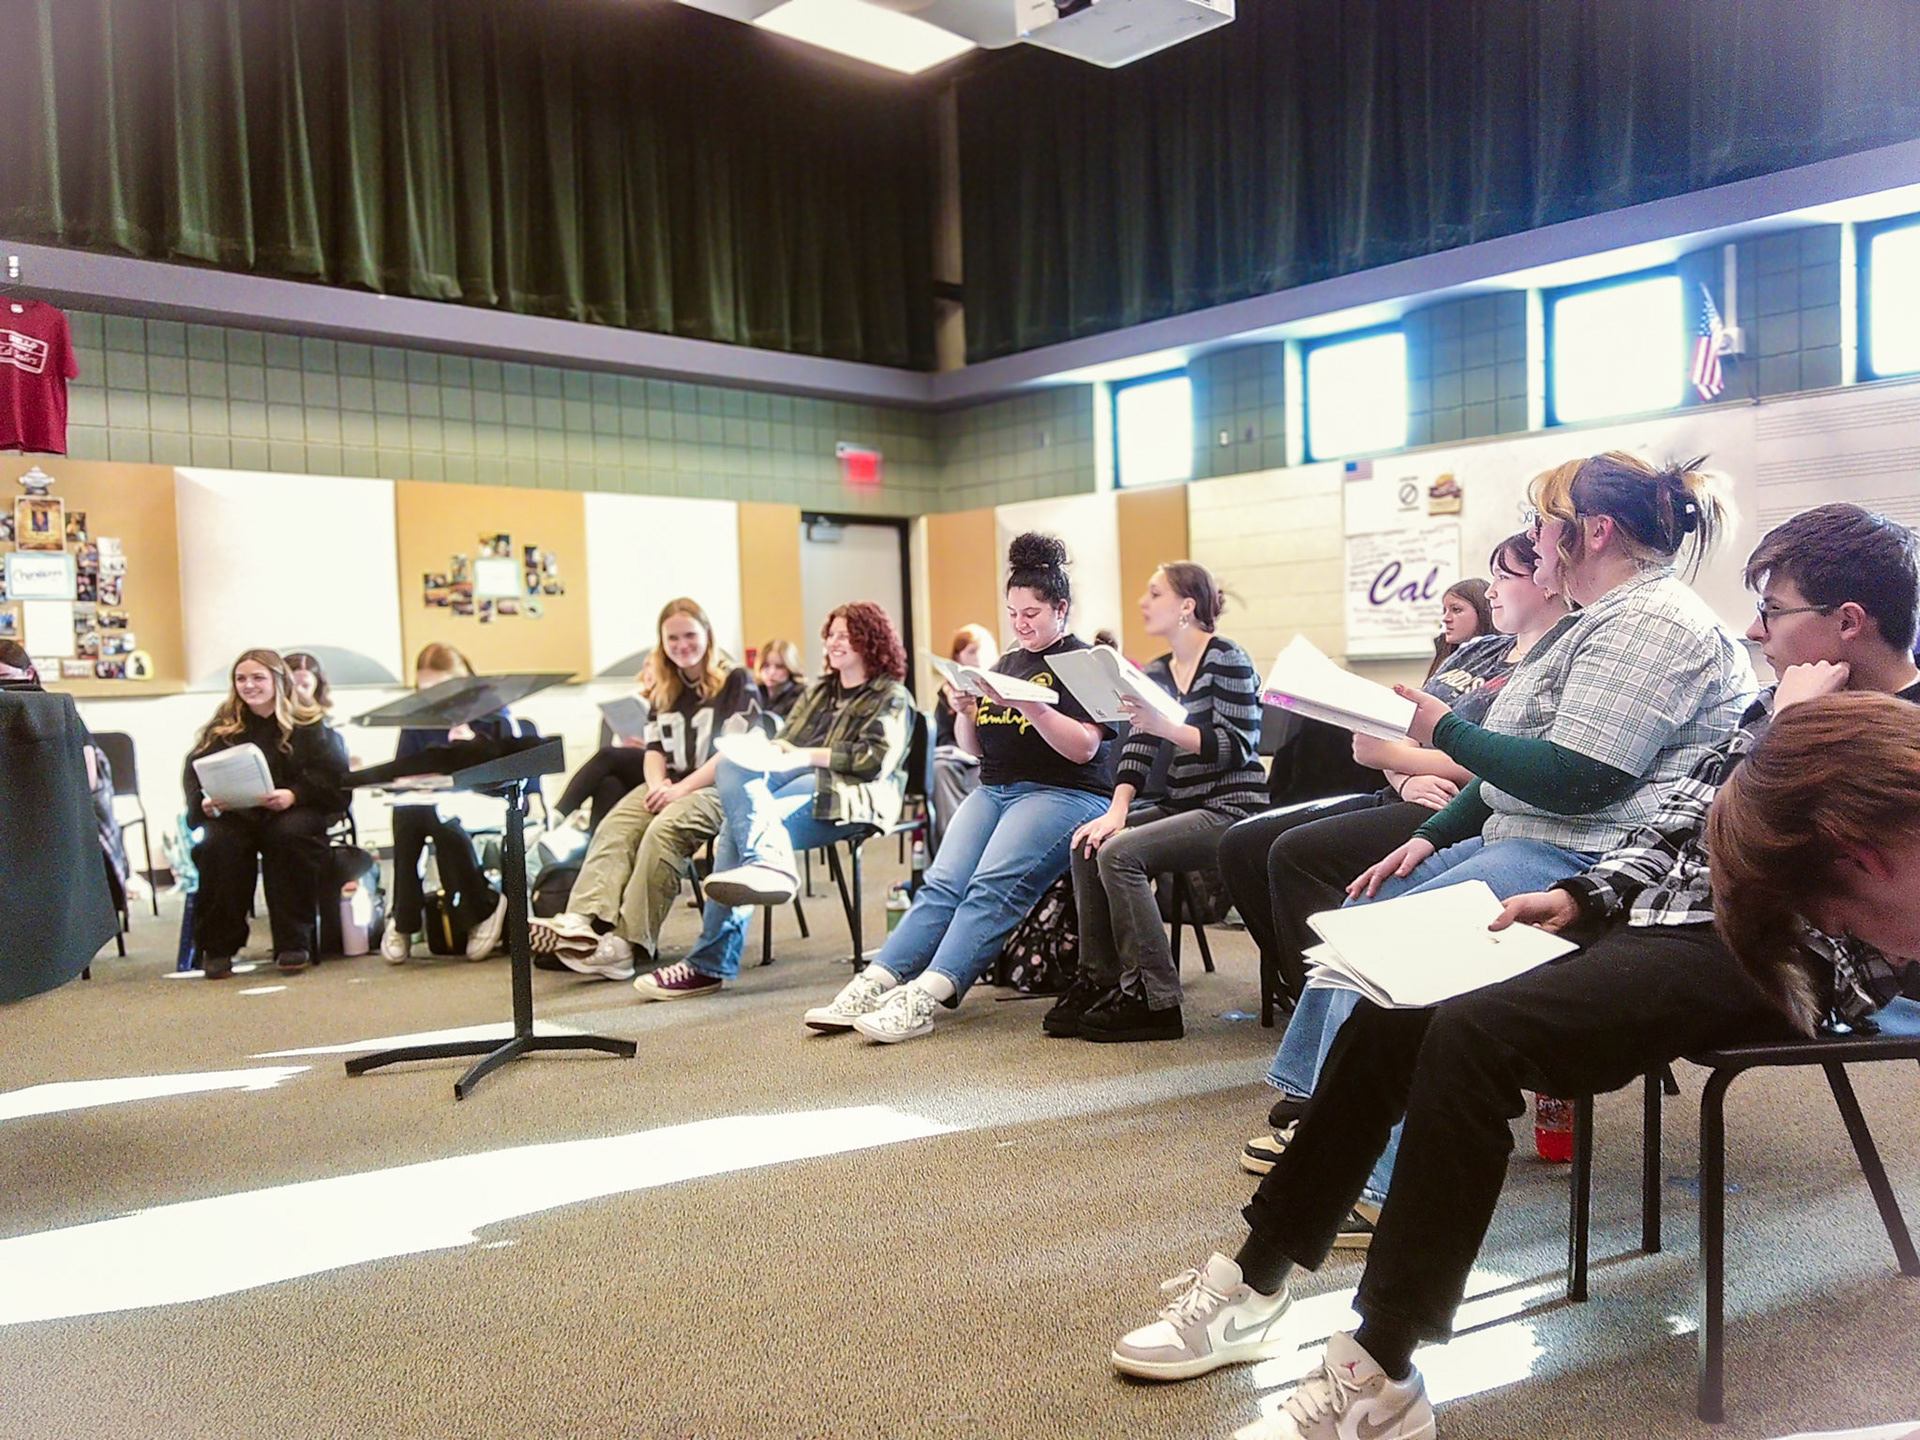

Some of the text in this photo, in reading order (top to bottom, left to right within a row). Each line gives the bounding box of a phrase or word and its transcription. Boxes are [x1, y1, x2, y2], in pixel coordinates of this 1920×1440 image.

[1369, 560, 1439, 605] Cal
[657, 707, 714, 773] 91
[976, 705, 1031, 735] Family
